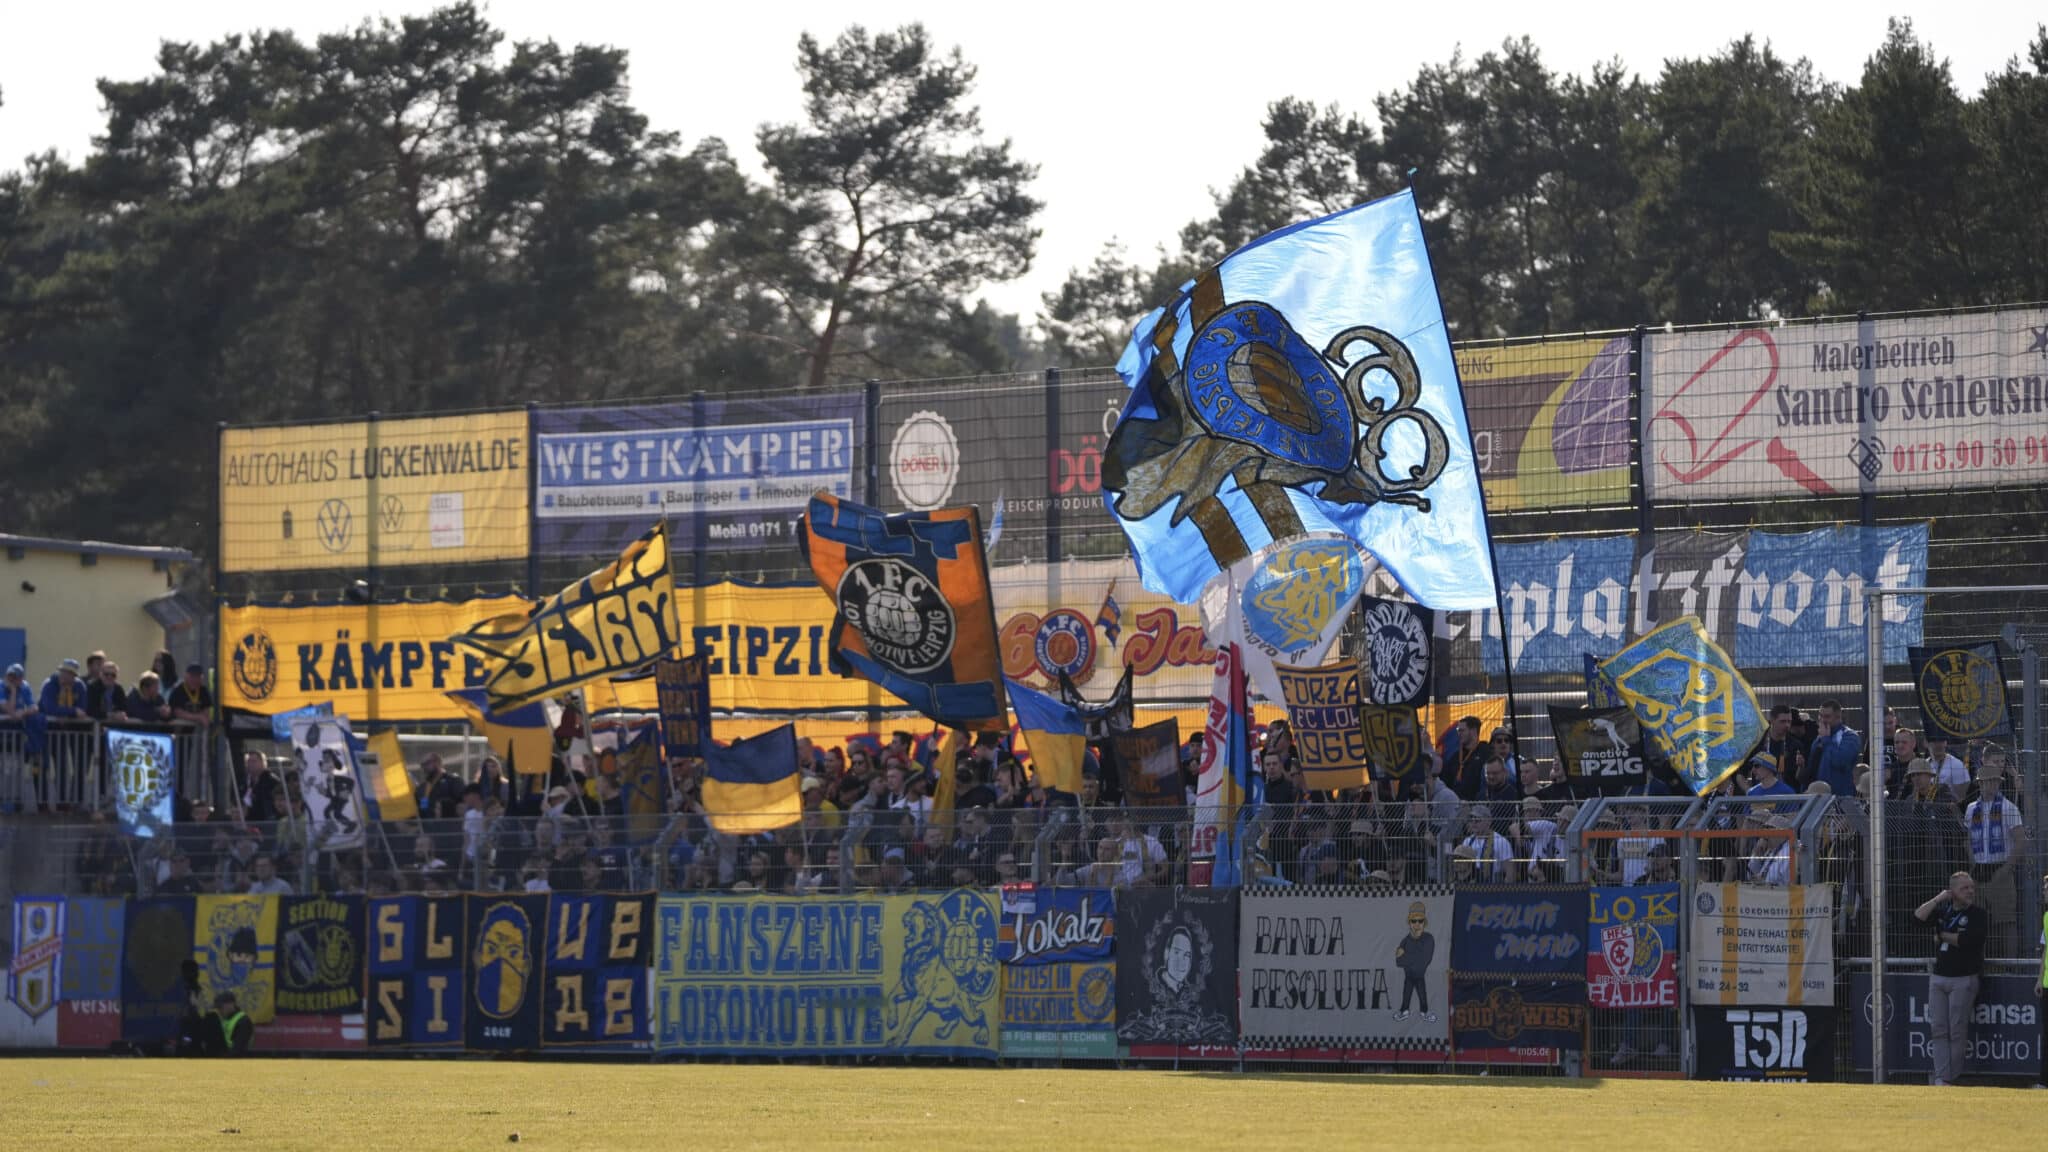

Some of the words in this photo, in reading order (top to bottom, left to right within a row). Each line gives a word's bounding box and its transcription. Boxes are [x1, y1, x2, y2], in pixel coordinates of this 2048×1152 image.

[1813, 336, 1955, 373] Malerbetrieb
[1776, 381, 1890, 427] Sandro
[226, 449, 338, 486] AUTOHAUS
[349, 437, 520, 480] LUCKENWALDE
[543, 428, 843, 480] WESTKÄMPER
[1992, 437, 2018, 468] 50
[992, 497, 1105, 513] FEISCHPRODUKT
[709, 524, 746, 539] Mobil
[749, 522, 780, 537] 0171
[855, 563, 928, 605] 1.FC
[692, 624, 844, 676] EIPZI
[1280, 674, 1362, 705] FORZA
[1589, 893, 1678, 923] LOK
[657, 901, 884, 976] FANSZENE
[1253, 915, 1345, 956] BANDA
[1606, 926, 1629, 940] HFC
[1716, 925, 1735, 937] FÜR
[1737, 927, 1755, 937] DEN
[1757, 928, 1788, 938] ERHALT
[1250, 968, 1392, 1011] RESOLUTA
[1588, 979, 1677, 1007] HALLE
[1719, 981, 1731, 992] 24
[1738, 981, 1750, 992] 32
[657, 983, 884, 1048] LOKOMOTIVE
[1522, 1005, 1584, 1027] WEST
[1035, 1031, 1107, 1041] MEDINTECHNIK
[1909, 1032, 2030, 1060] Reebüro
